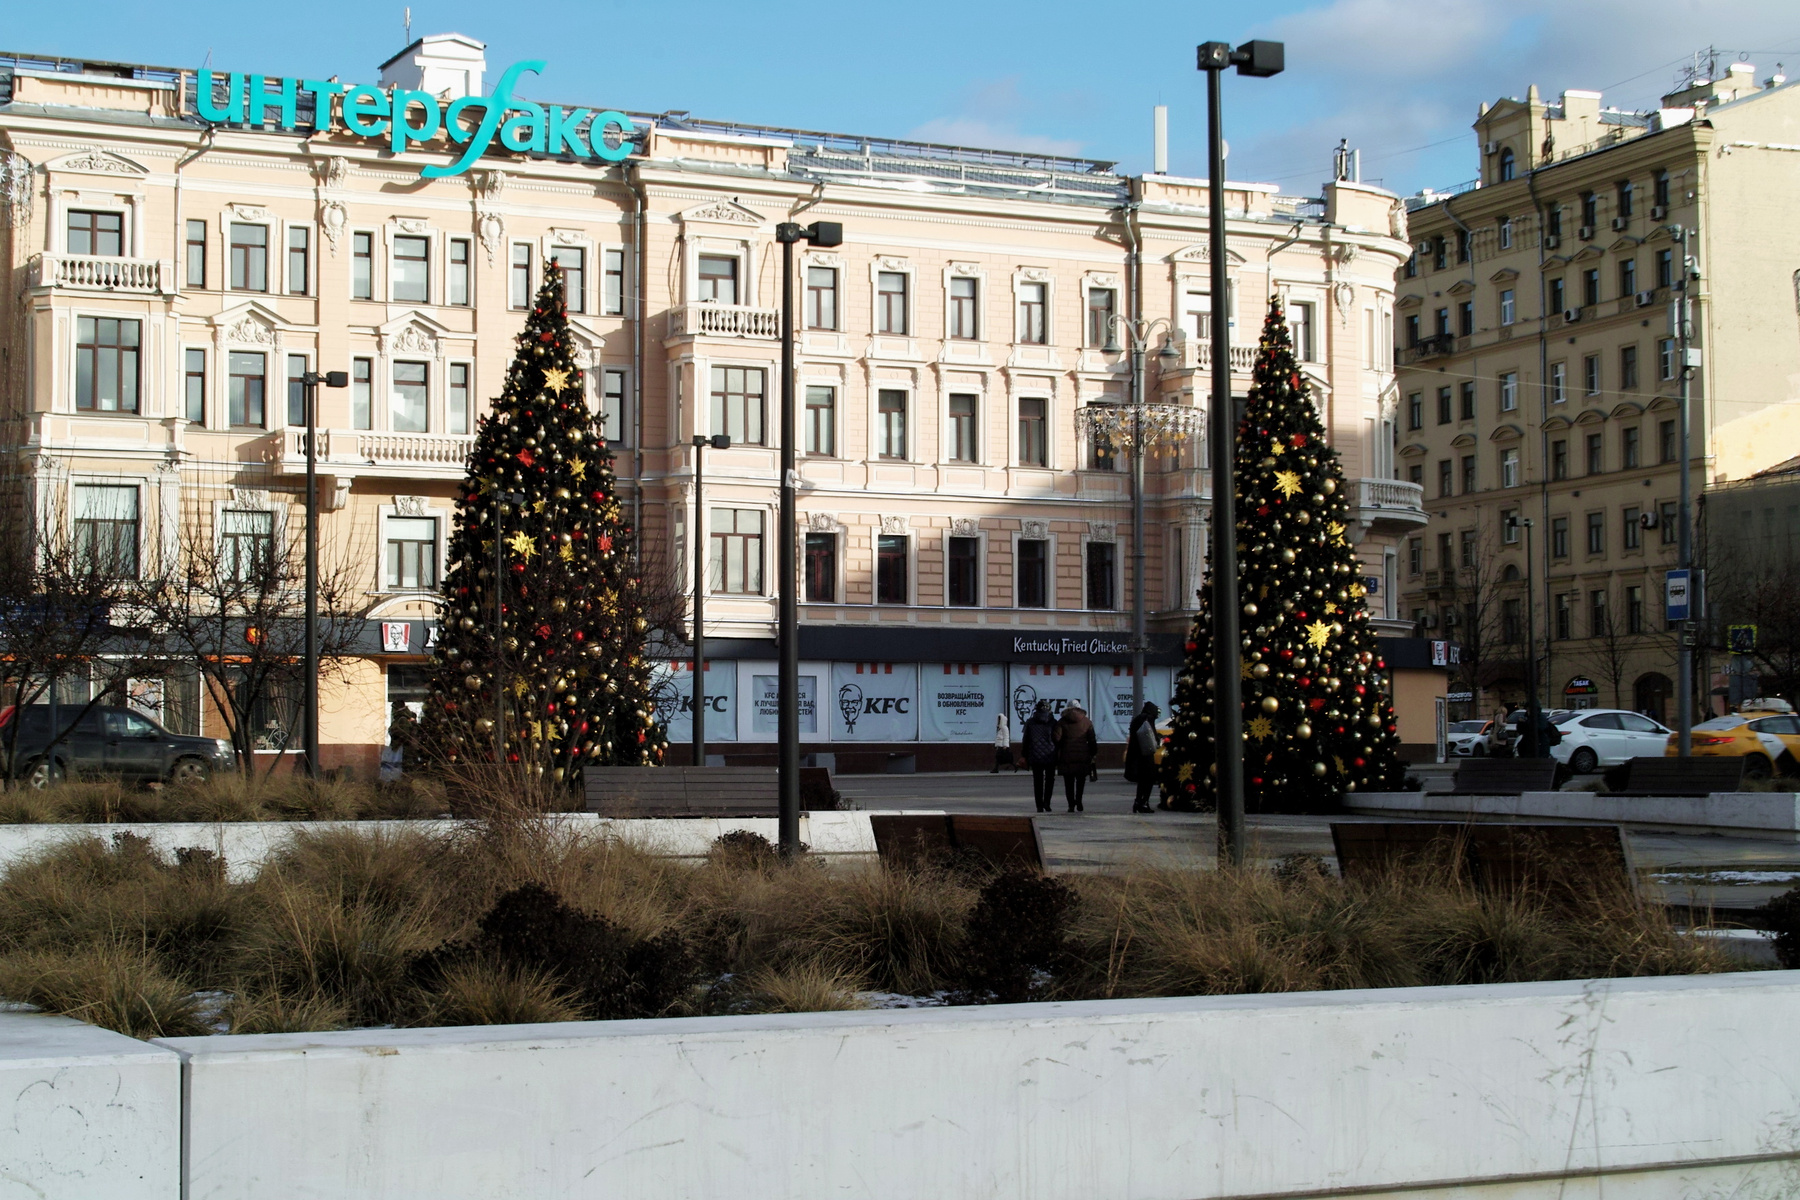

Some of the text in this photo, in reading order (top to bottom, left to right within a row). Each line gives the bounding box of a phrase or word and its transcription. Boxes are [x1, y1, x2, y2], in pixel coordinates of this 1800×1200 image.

[197, 60, 635, 178] интерфакс
[1014, 637, 1128, 655] Kentucky Fried Chicken
[680, 695, 728, 712] KFC
[937, 691, 985, 700] ВОЗВРАЩАЙТЕСЬ
[937, 700, 984, 708] В ОБНОВЛЕННЫЙ
[863, 697, 910, 714] KFC
